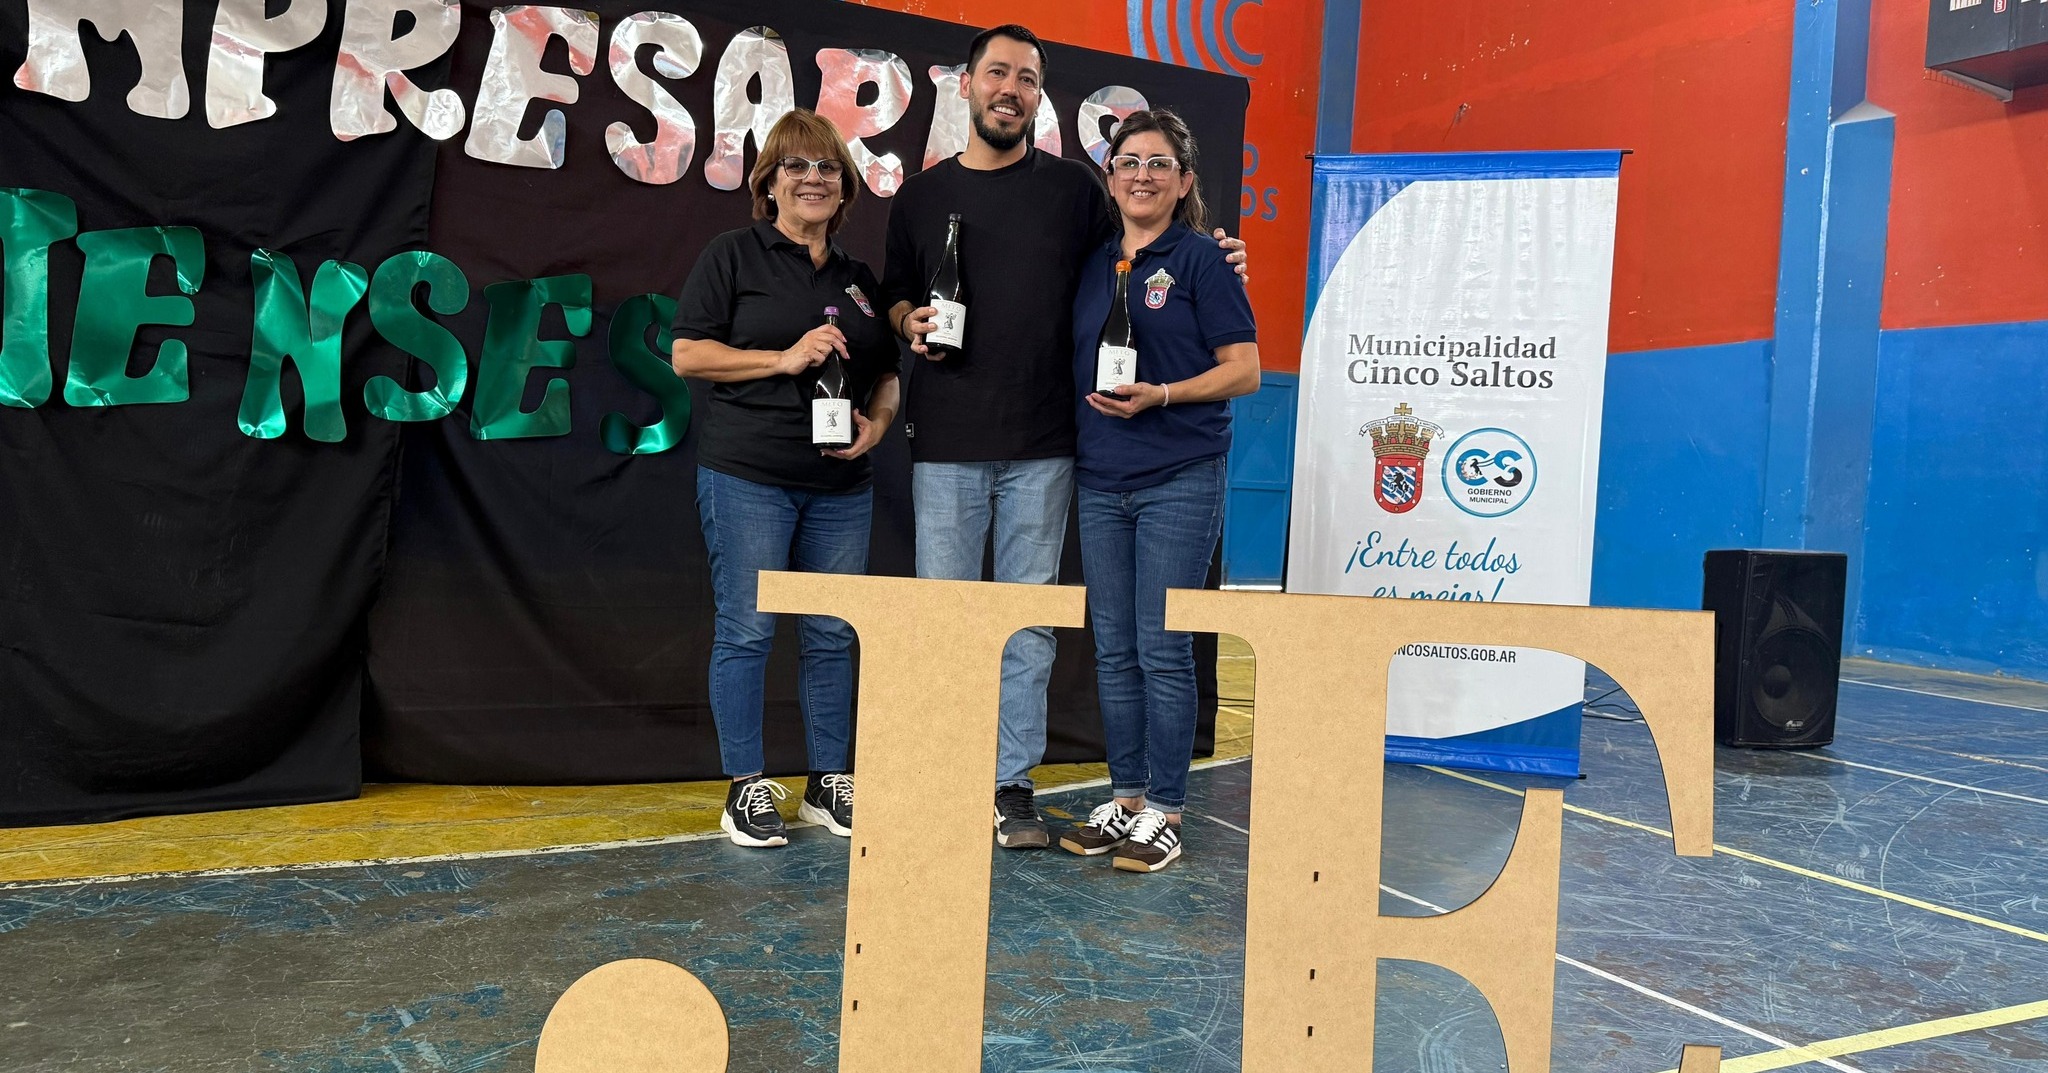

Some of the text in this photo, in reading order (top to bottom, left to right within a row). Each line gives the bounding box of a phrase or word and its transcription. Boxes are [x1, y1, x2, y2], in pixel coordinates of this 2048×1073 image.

[1347, 333, 1557, 362] Municipalidad
[1347, 358, 1554, 389] Cinco Saltos
[1455, 448, 1523, 488] CS
[1467, 488, 1512, 497] GOBIERNO
[1469, 496, 1509, 505] MUNICIPAL
[1345, 530, 1522, 574] ¡Entre todos
